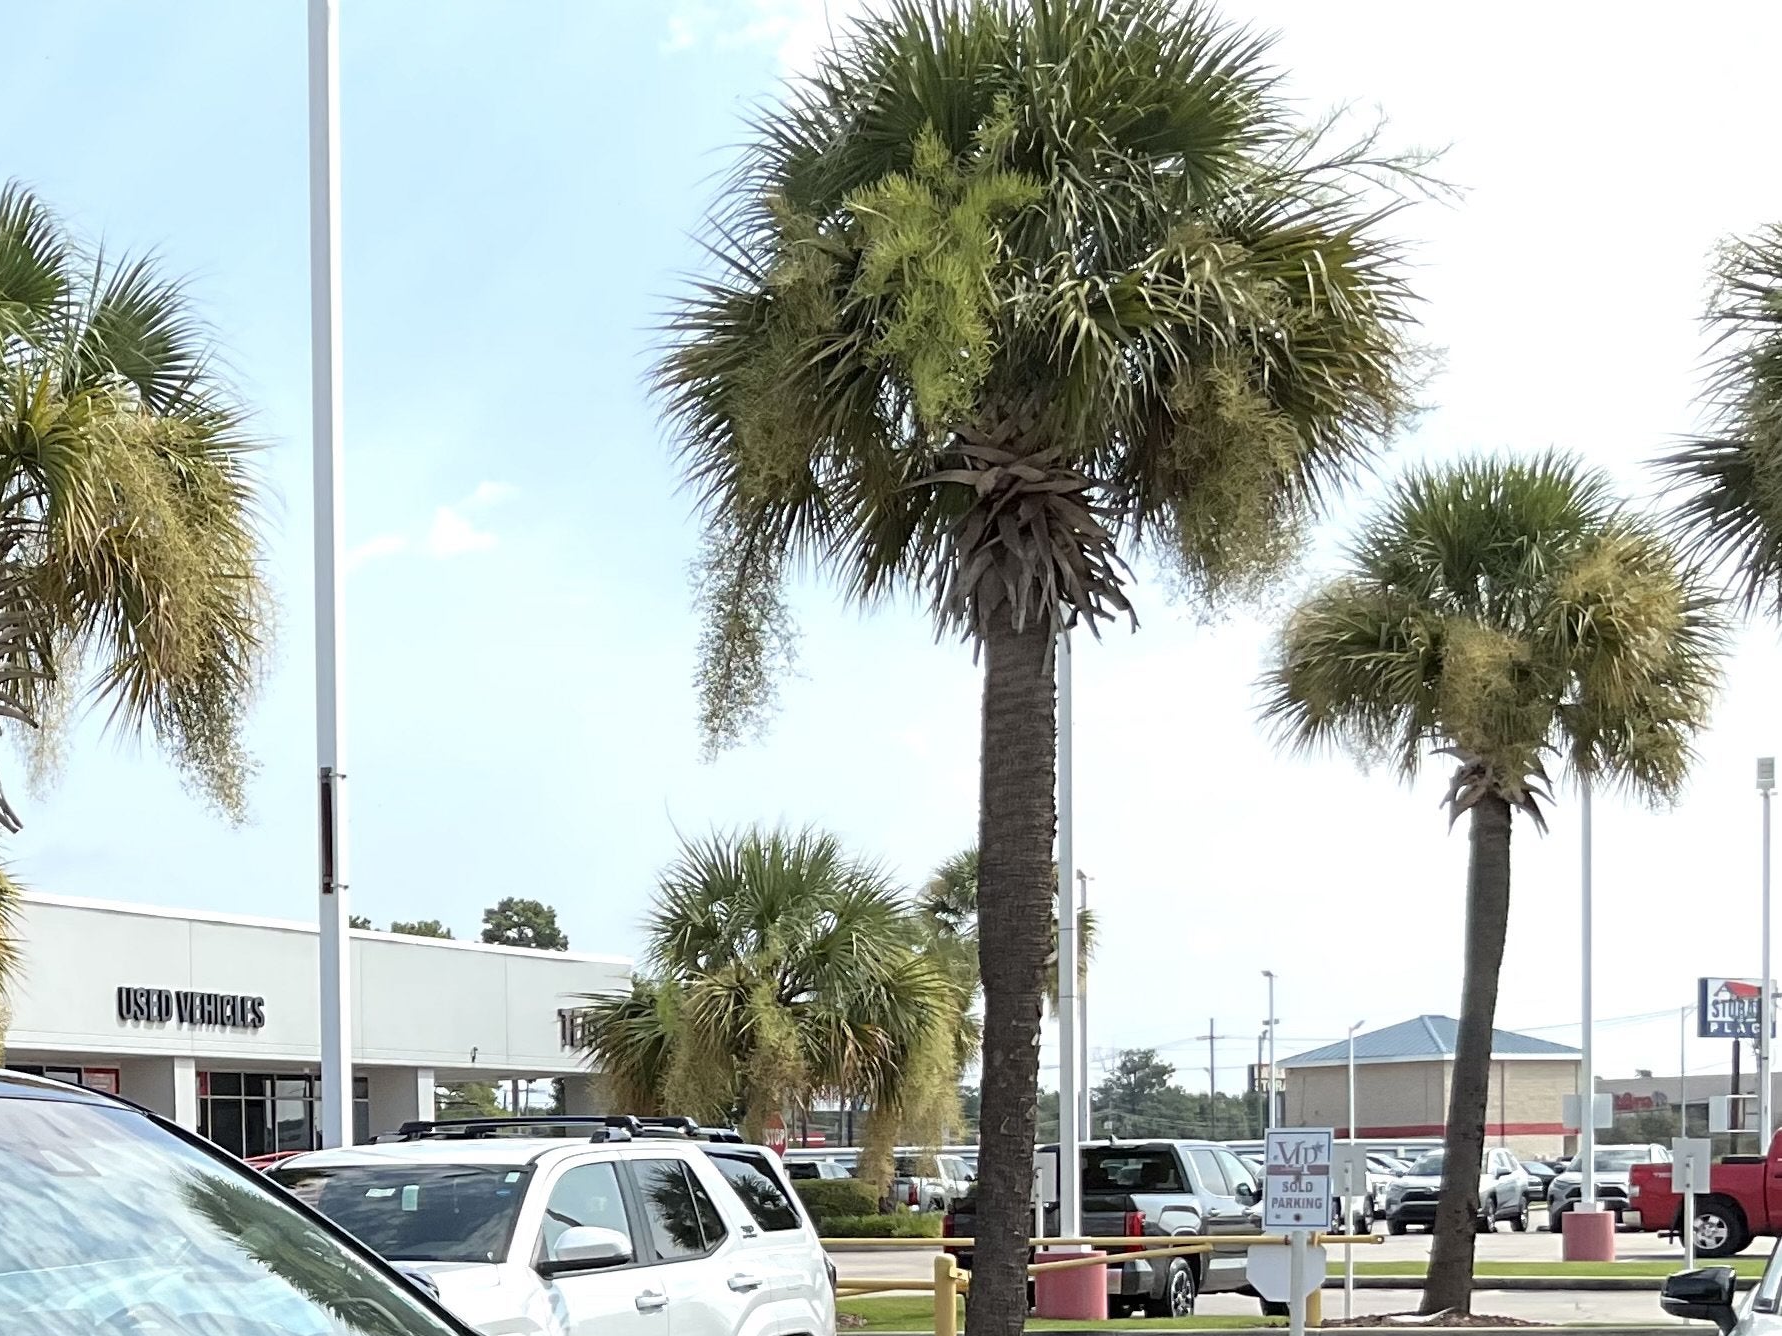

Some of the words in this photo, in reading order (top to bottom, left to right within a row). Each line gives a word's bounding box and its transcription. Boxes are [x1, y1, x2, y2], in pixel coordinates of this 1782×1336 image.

[118, 986, 172, 1022] USED
[175, 990, 265, 1028] VEHICLES
[1710, 1022, 1760, 1033] PLAC
[1282, 1181, 1314, 1193] SOLD
[1271, 1197, 1323, 1210] PARKING
